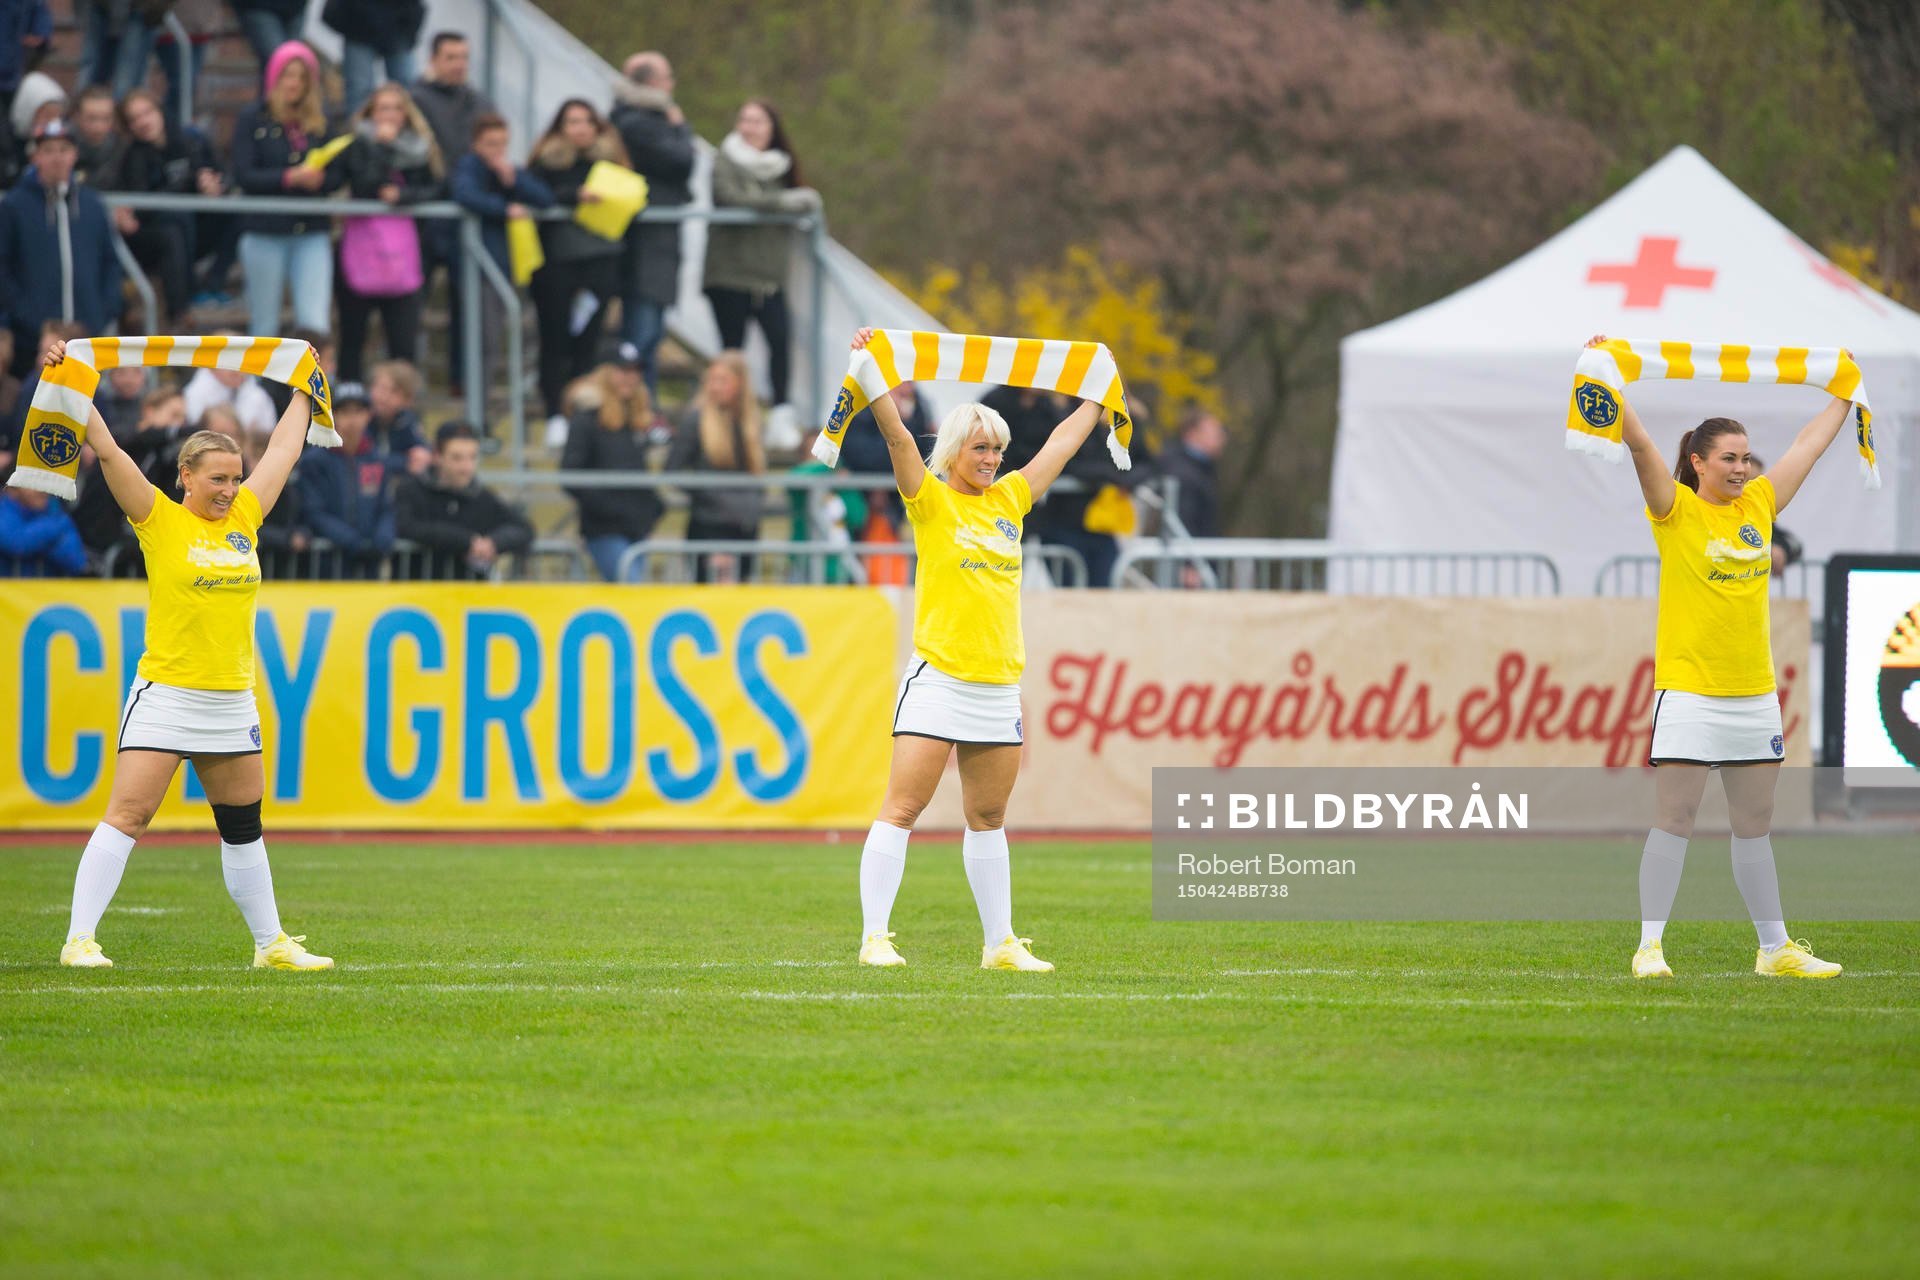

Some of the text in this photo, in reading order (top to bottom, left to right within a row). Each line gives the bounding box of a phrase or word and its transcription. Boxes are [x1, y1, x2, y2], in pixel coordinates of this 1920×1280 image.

[20, 605, 811, 804] CY GROSS
[1046, 650, 1801, 773] Heagårds Skafi
